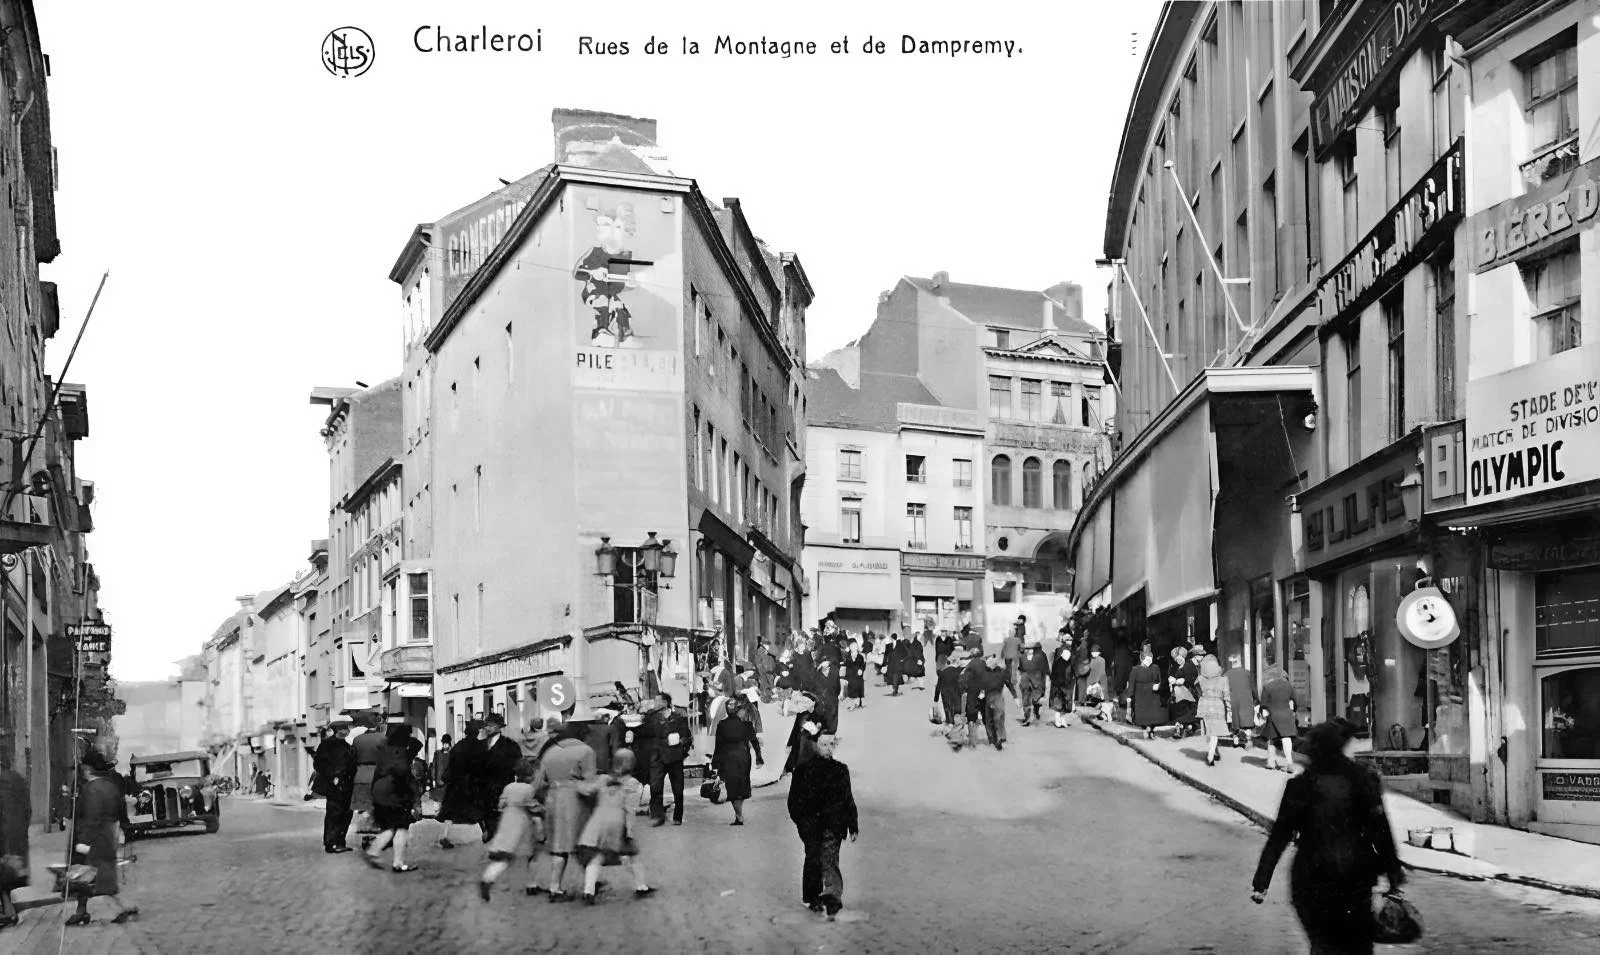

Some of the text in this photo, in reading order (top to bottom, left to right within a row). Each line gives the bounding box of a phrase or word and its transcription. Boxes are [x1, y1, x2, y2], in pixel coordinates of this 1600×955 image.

[577, 352, 613, 370] PILE
[1510, 391, 1557, 422] STADE
[1522, 421, 1537, 440] DE
[1546, 404, 1600, 434] DIVISIO
[1471, 439, 1566, 498] OLYMPIC
